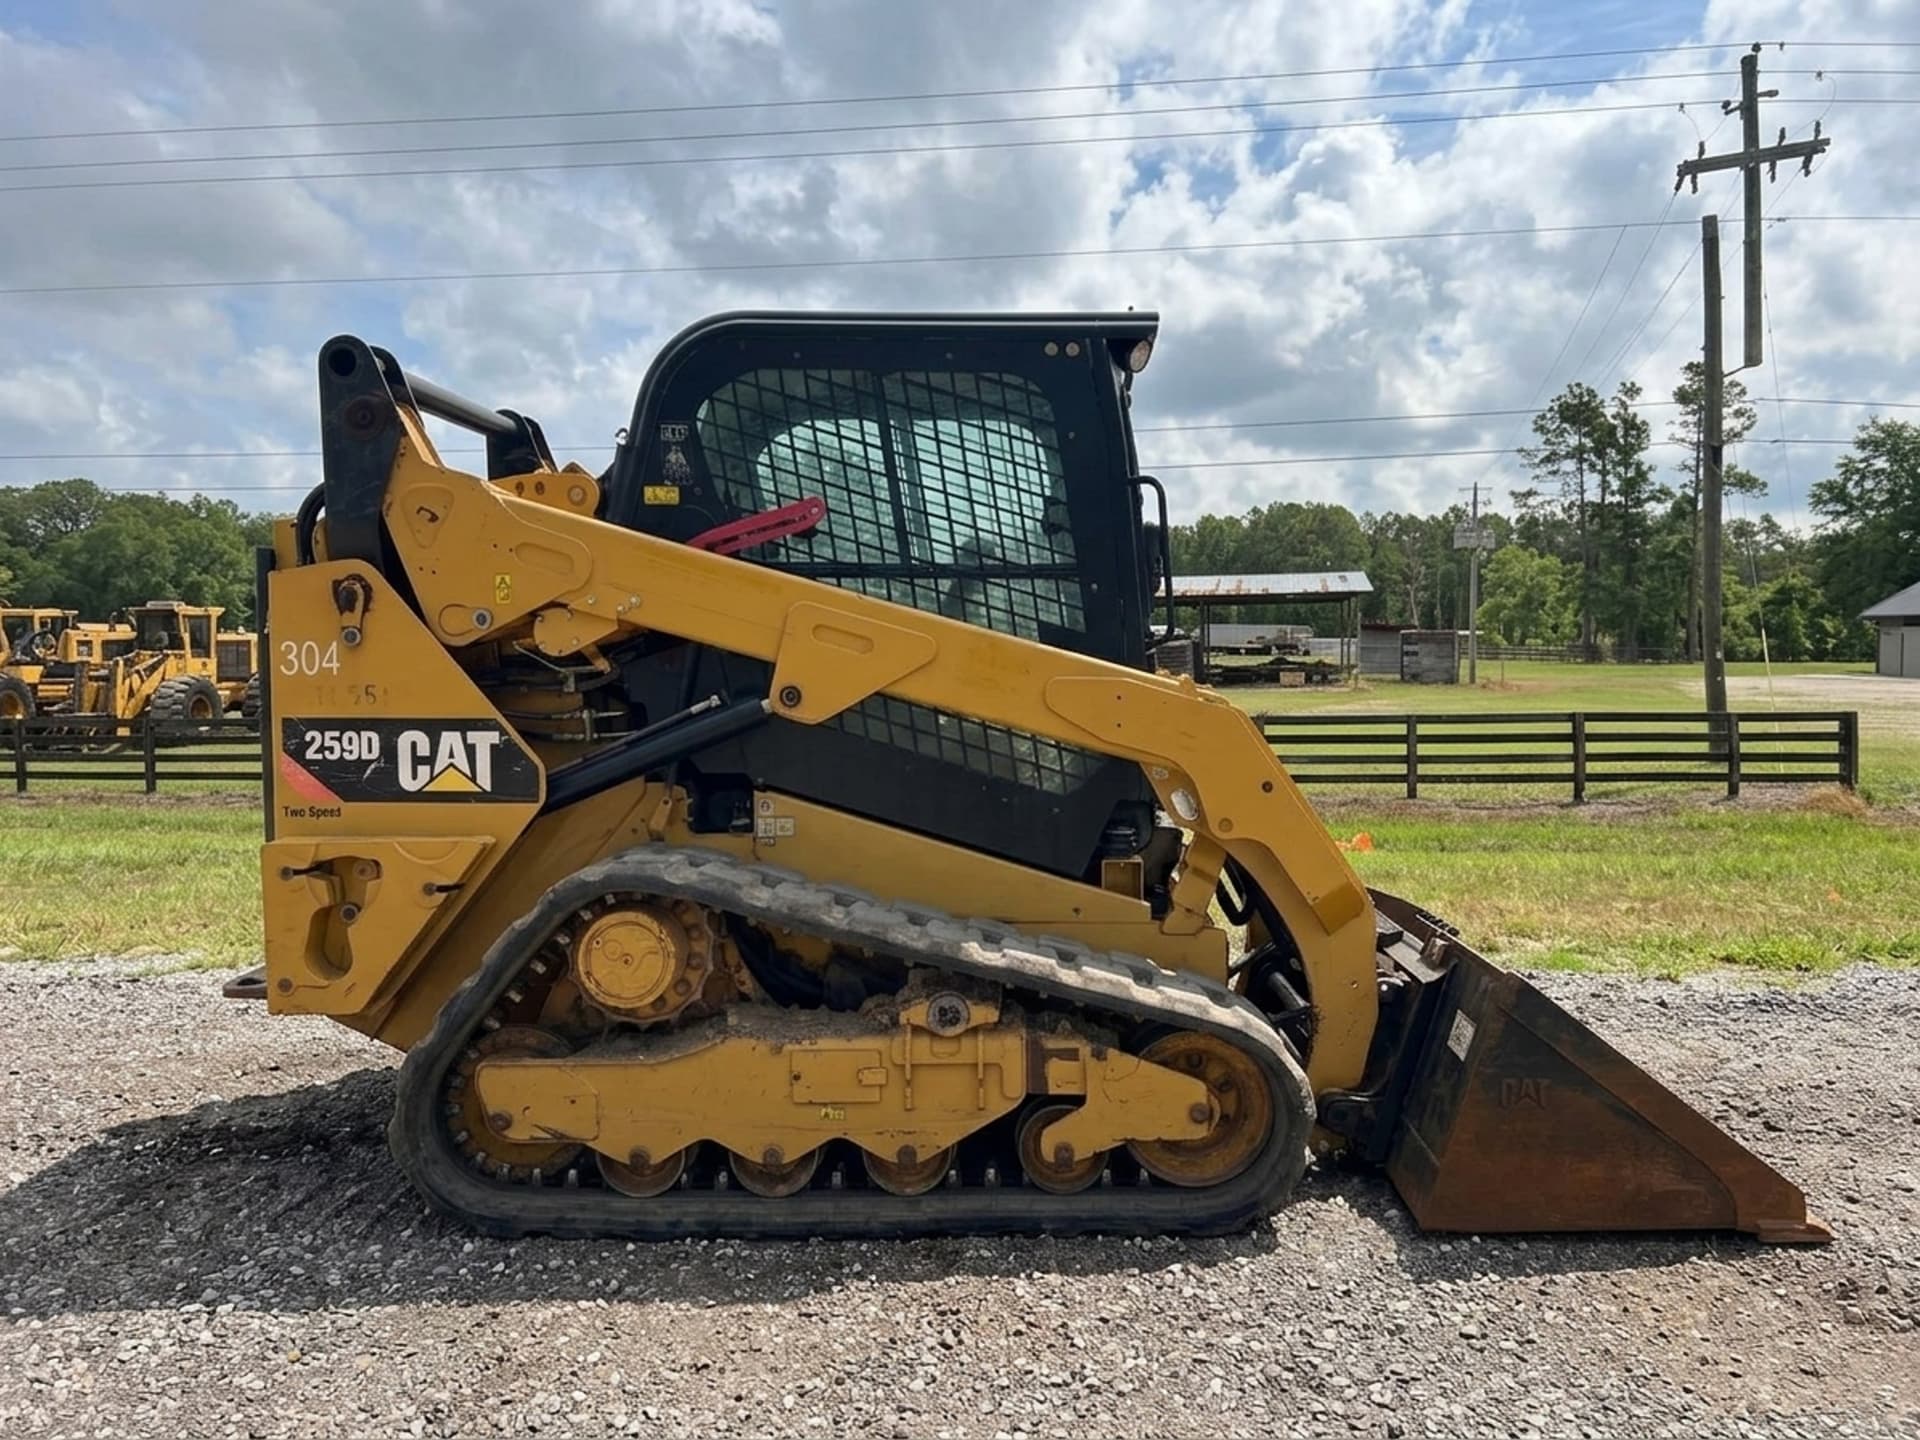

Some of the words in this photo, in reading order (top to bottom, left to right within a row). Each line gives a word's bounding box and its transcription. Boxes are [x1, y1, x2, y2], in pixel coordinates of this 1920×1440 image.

[279, 640, 341, 676] 304
[304, 730, 380, 761] 259D
[397, 730, 500, 792] CAT
[283, 806, 306, 818] Two
[308, 806, 341, 819] Speed
